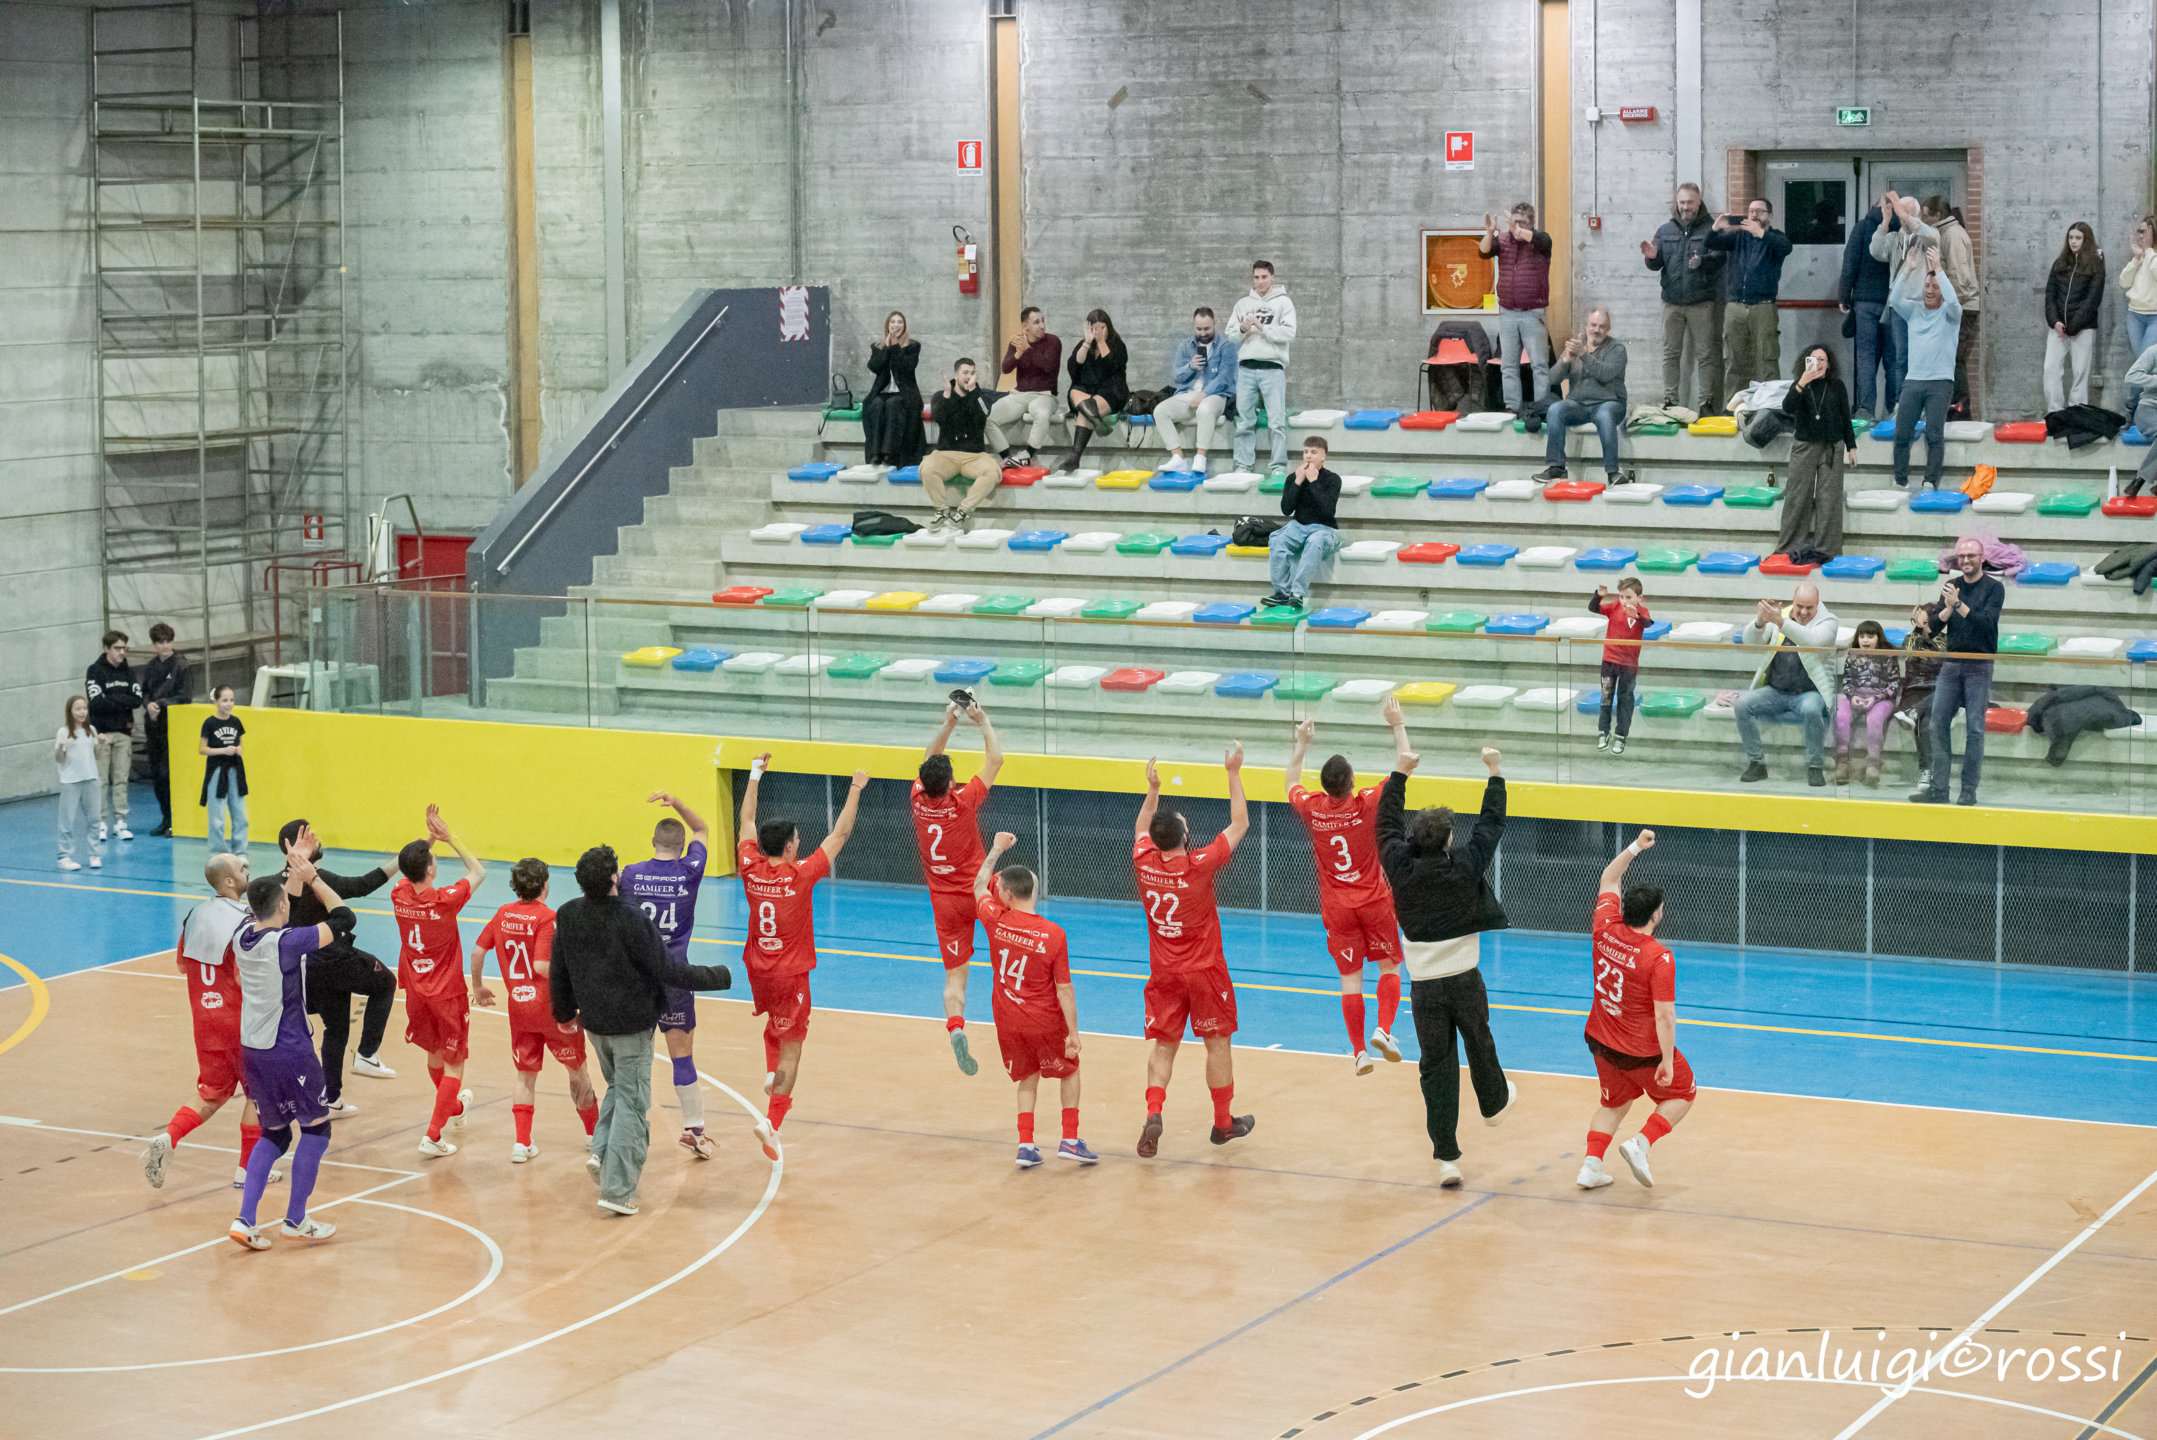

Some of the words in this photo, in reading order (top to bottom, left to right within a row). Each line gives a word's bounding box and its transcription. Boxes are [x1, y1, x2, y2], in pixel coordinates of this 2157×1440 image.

[927, 824, 948, 861] 2
[1330, 835, 1353, 872] 3
[633, 883, 675, 893] GAMIFER
[635, 874, 677, 882] SEPRIO
[747, 880, 782, 894] GAMIFER
[1141, 872, 1175, 886] GAMIFER
[394, 905, 427, 917] GAMIFER
[759, 901, 777, 937] 8
[1146, 890, 1183, 927] 22
[408, 924, 425, 955] 4
[995, 927, 1035, 948] GAMIFER
[1597, 941, 1628, 961] GAMIFER
[505, 939, 533, 980] 21
[998, 948, 1028, 991] 14
[1595, 957, 1624, 1003] 23
